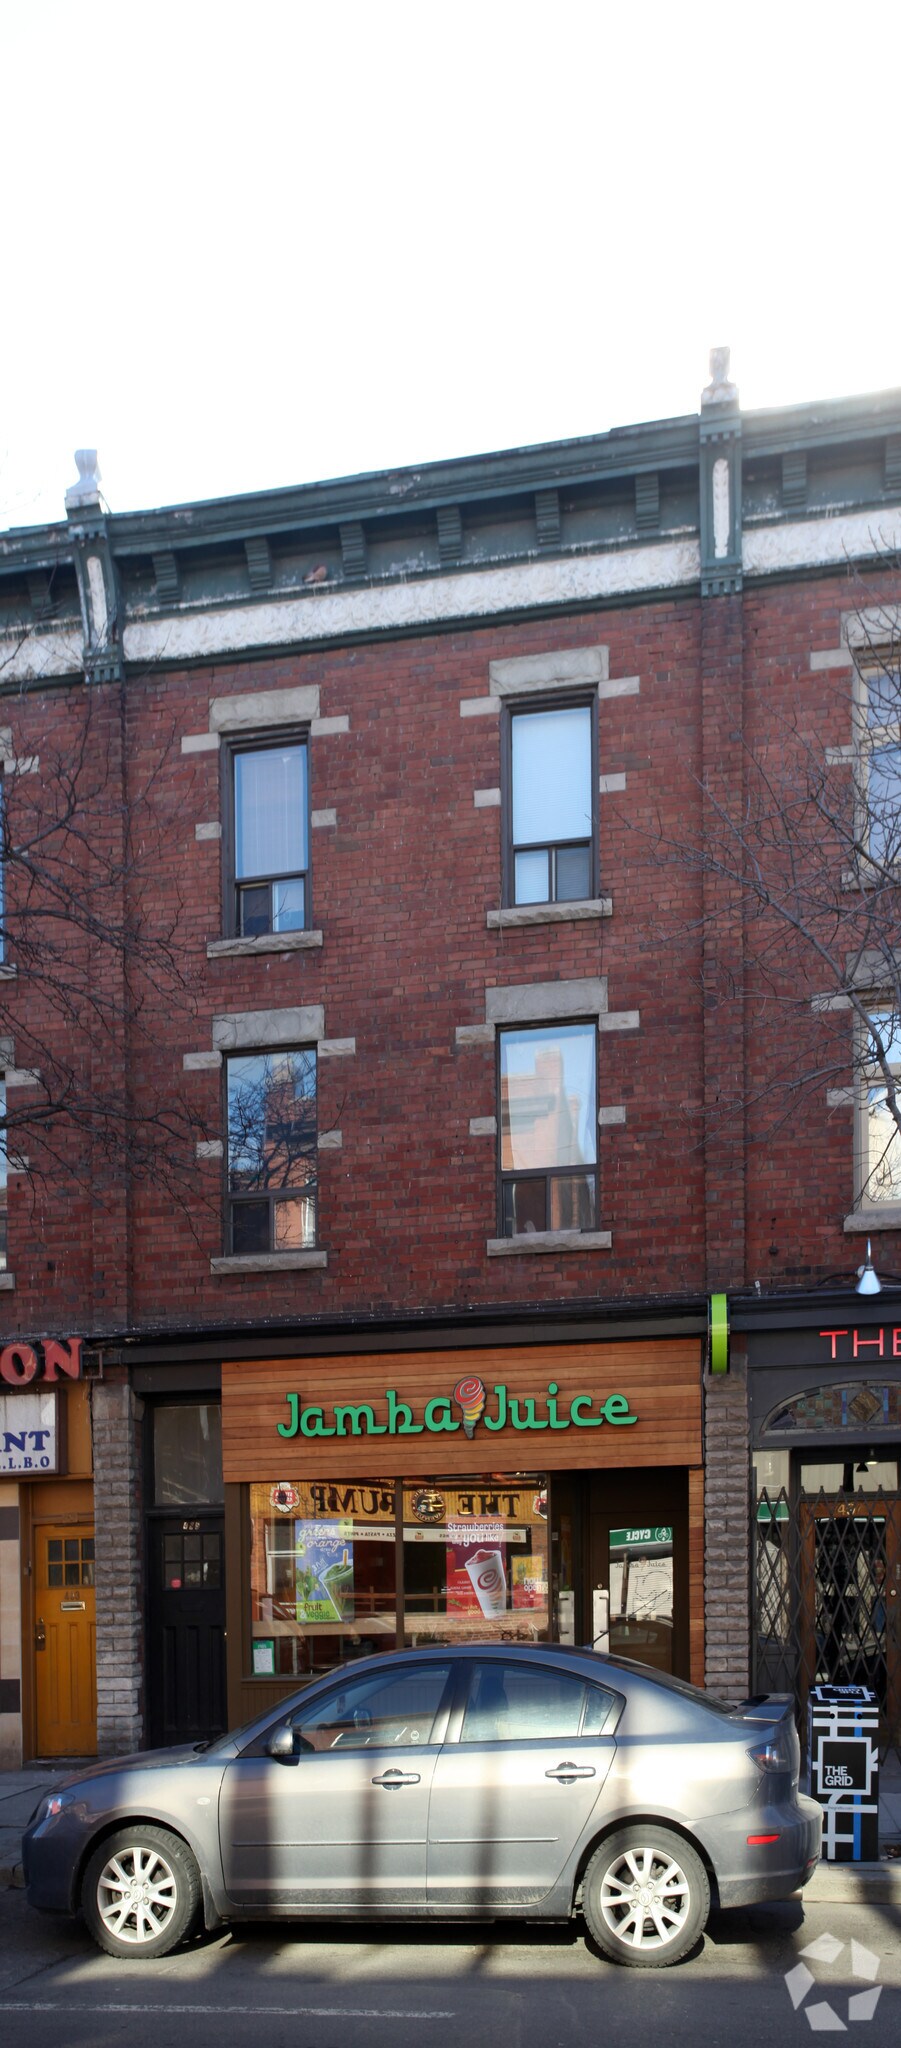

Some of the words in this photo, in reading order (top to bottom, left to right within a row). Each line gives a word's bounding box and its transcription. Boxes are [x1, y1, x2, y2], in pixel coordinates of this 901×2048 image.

[277, 1390, 460, 1438] Jamba
[484, 1382, 638, 1430] Juice
[0, 1430, 50, 1452] NT
[447, 1522, 504, 1532] Strawberries
[463, 1532, 484, 1547] you
[306, 1539, 346, 1553] orange
[304, 1602, 323, 1612] fruit
[825, 1766, 848, 1775] THE
[825, 1775, 853, 1786] GRID
